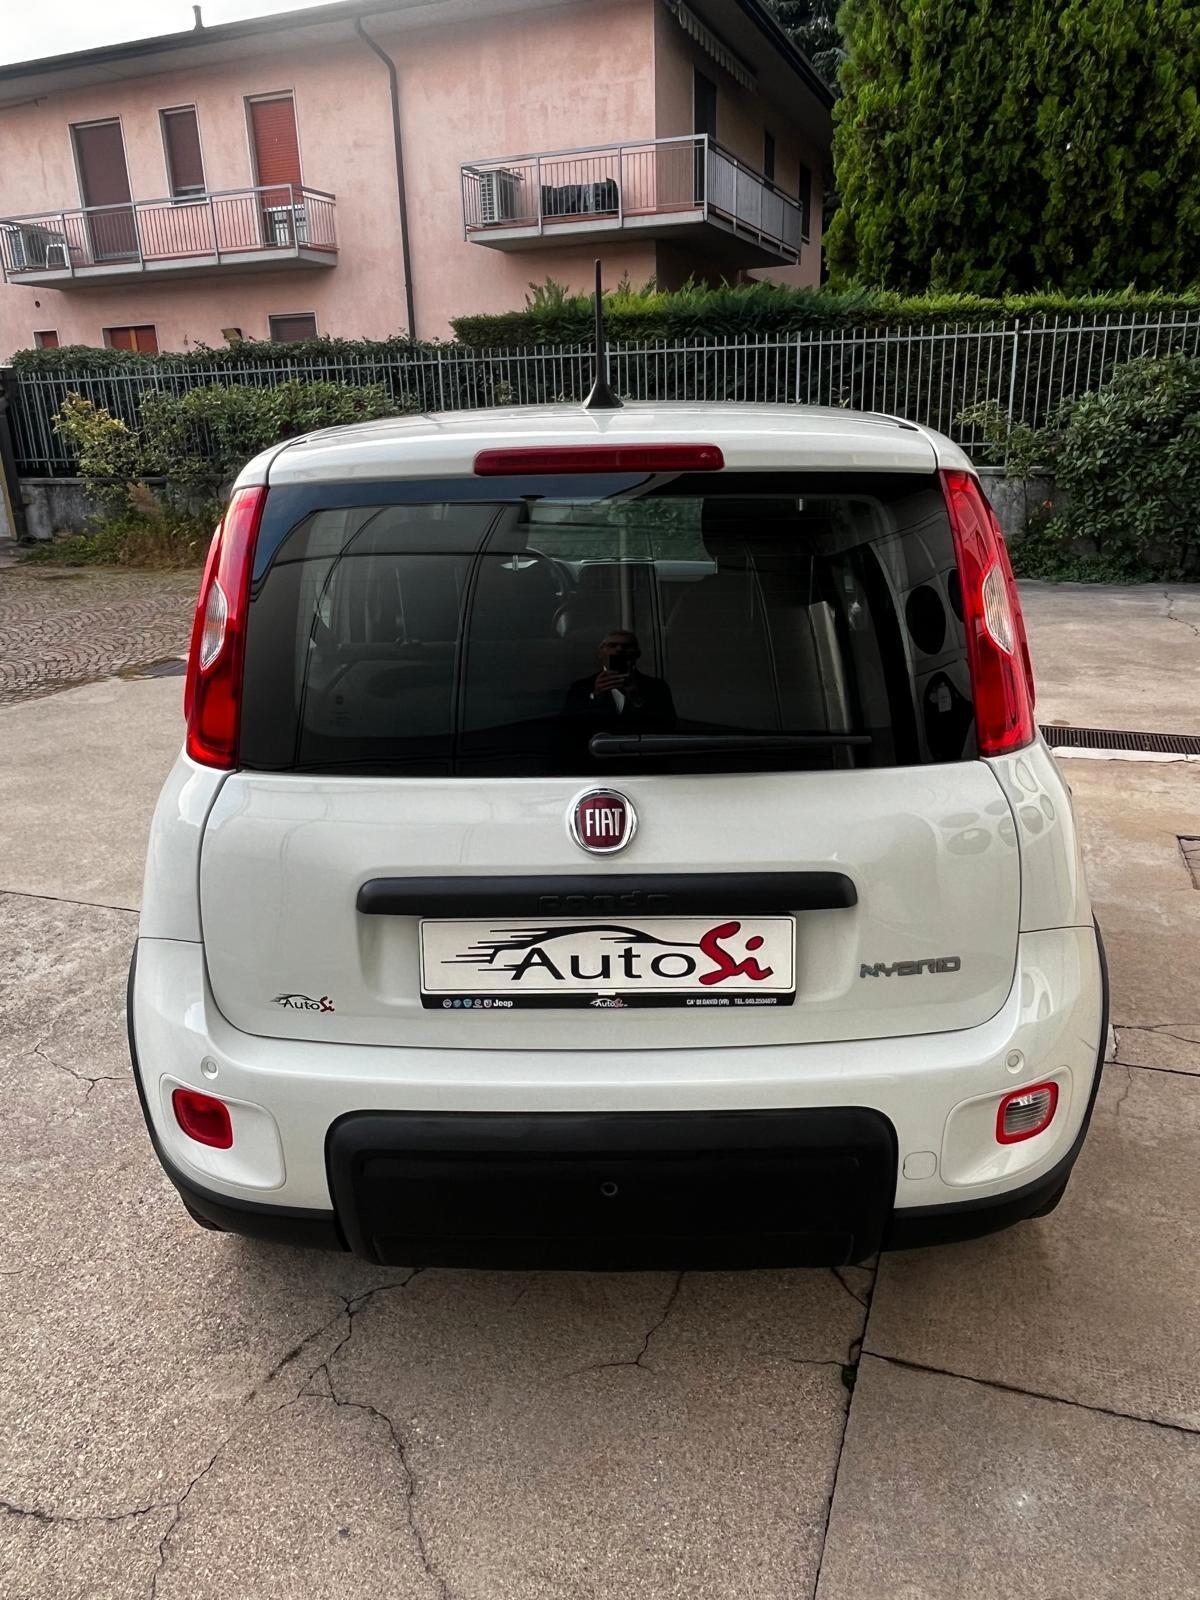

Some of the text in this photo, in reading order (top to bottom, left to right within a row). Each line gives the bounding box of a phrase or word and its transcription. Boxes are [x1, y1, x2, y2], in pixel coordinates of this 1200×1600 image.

[585, 808, 623, 837] FIAT
[859, 956, 961, 979] HYBRID
[493, 999, 513, 1008] Jeep
